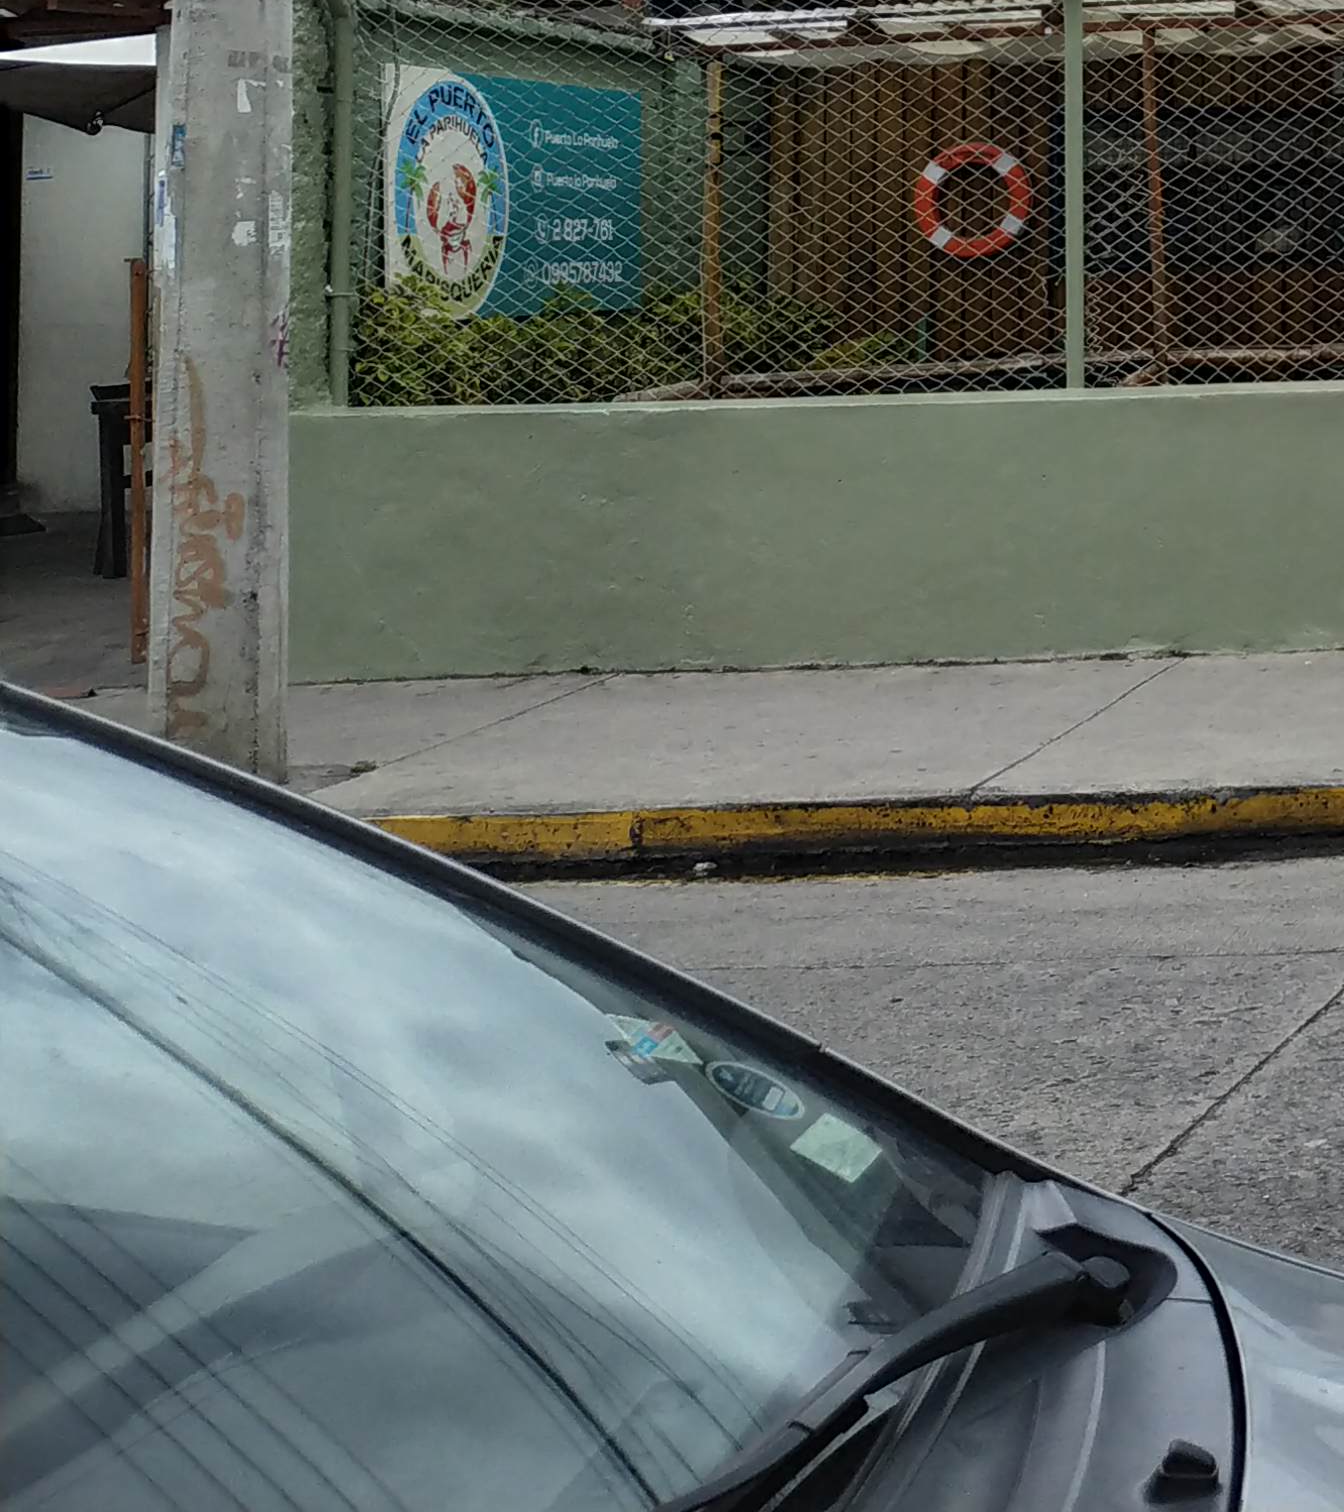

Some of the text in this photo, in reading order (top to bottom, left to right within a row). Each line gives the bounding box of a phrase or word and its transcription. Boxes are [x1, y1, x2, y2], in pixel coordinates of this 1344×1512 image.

[406, 85, 497, 149] EL PUERTO
[415, 115, 488, 165] LA PARIHUELA
[401, 235, 505, 302] MARISQUERIA
